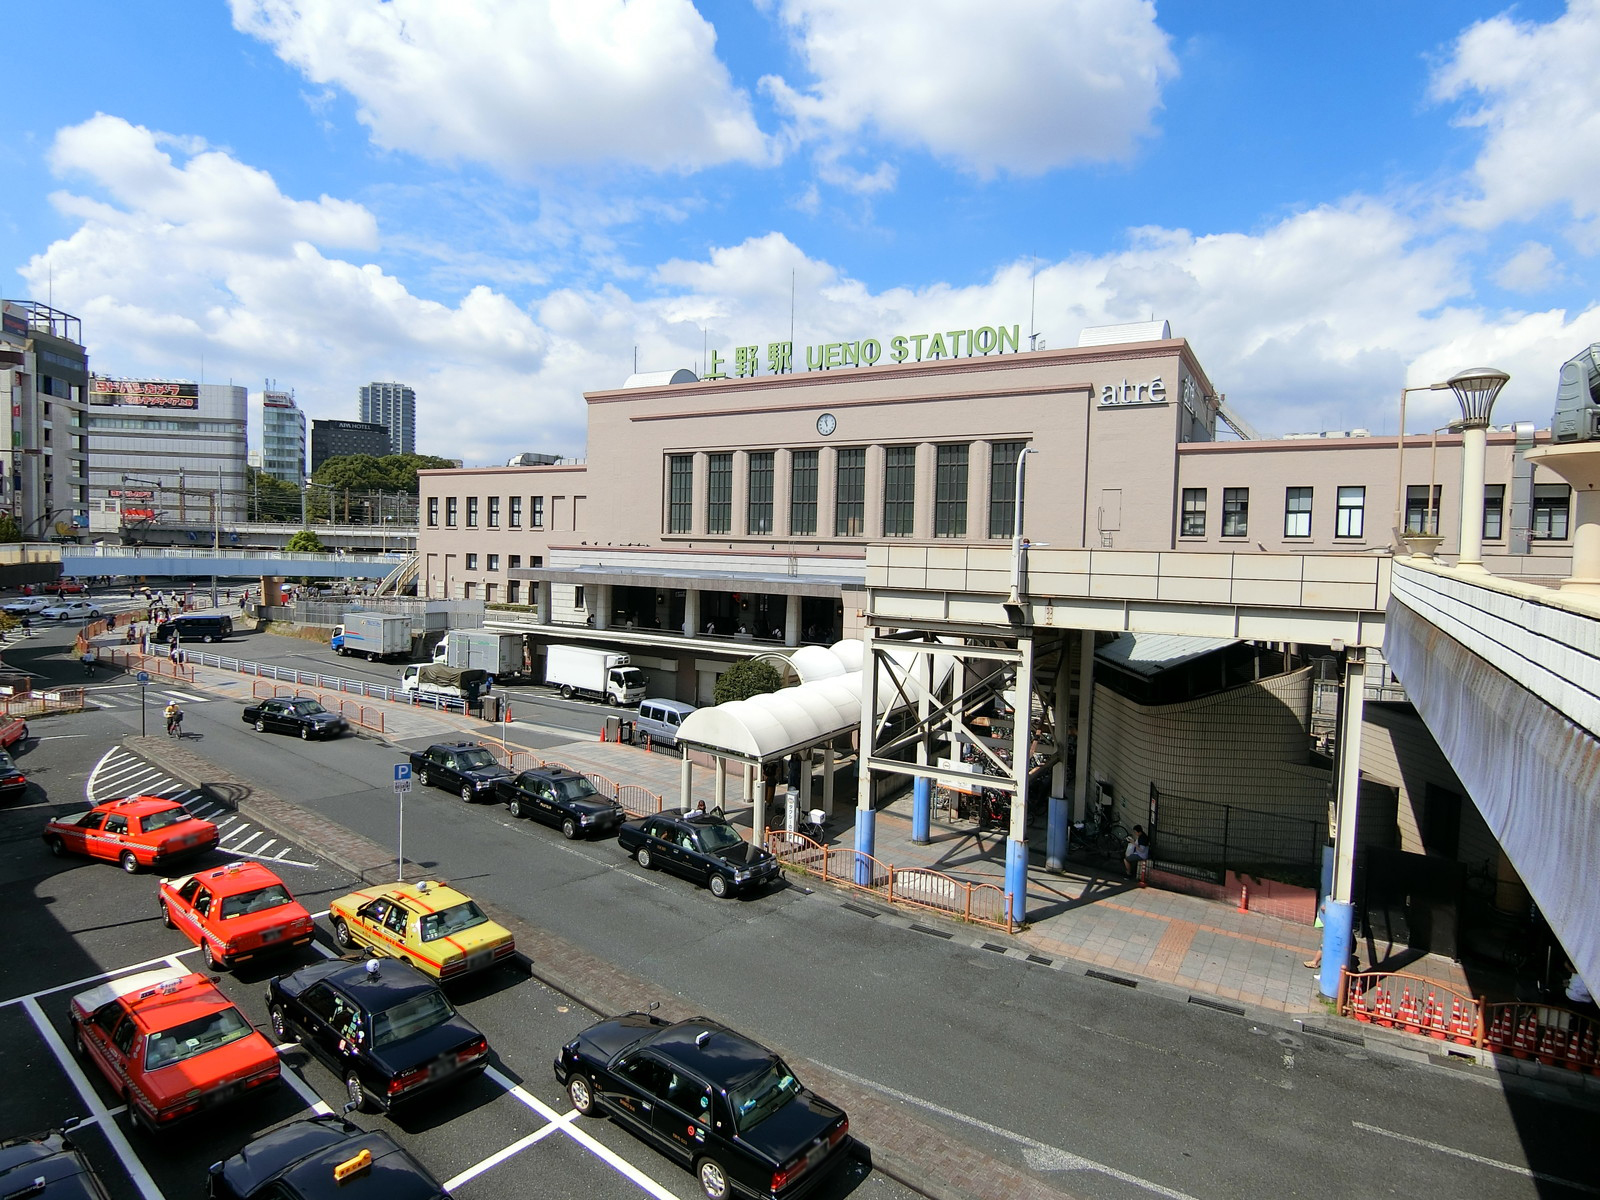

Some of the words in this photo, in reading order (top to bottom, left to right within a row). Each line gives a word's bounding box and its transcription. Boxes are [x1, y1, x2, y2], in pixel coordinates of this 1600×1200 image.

[704, 341, 793, 378] 上野駅
[806, 339, 882, 369] UENO
[890, 325, 1019, 362] STATION
[96, 381, 180, 395] ヨドバシカメラ
[1100, 376, 1166, 404] atré
[398, 765, 409, 779] P
